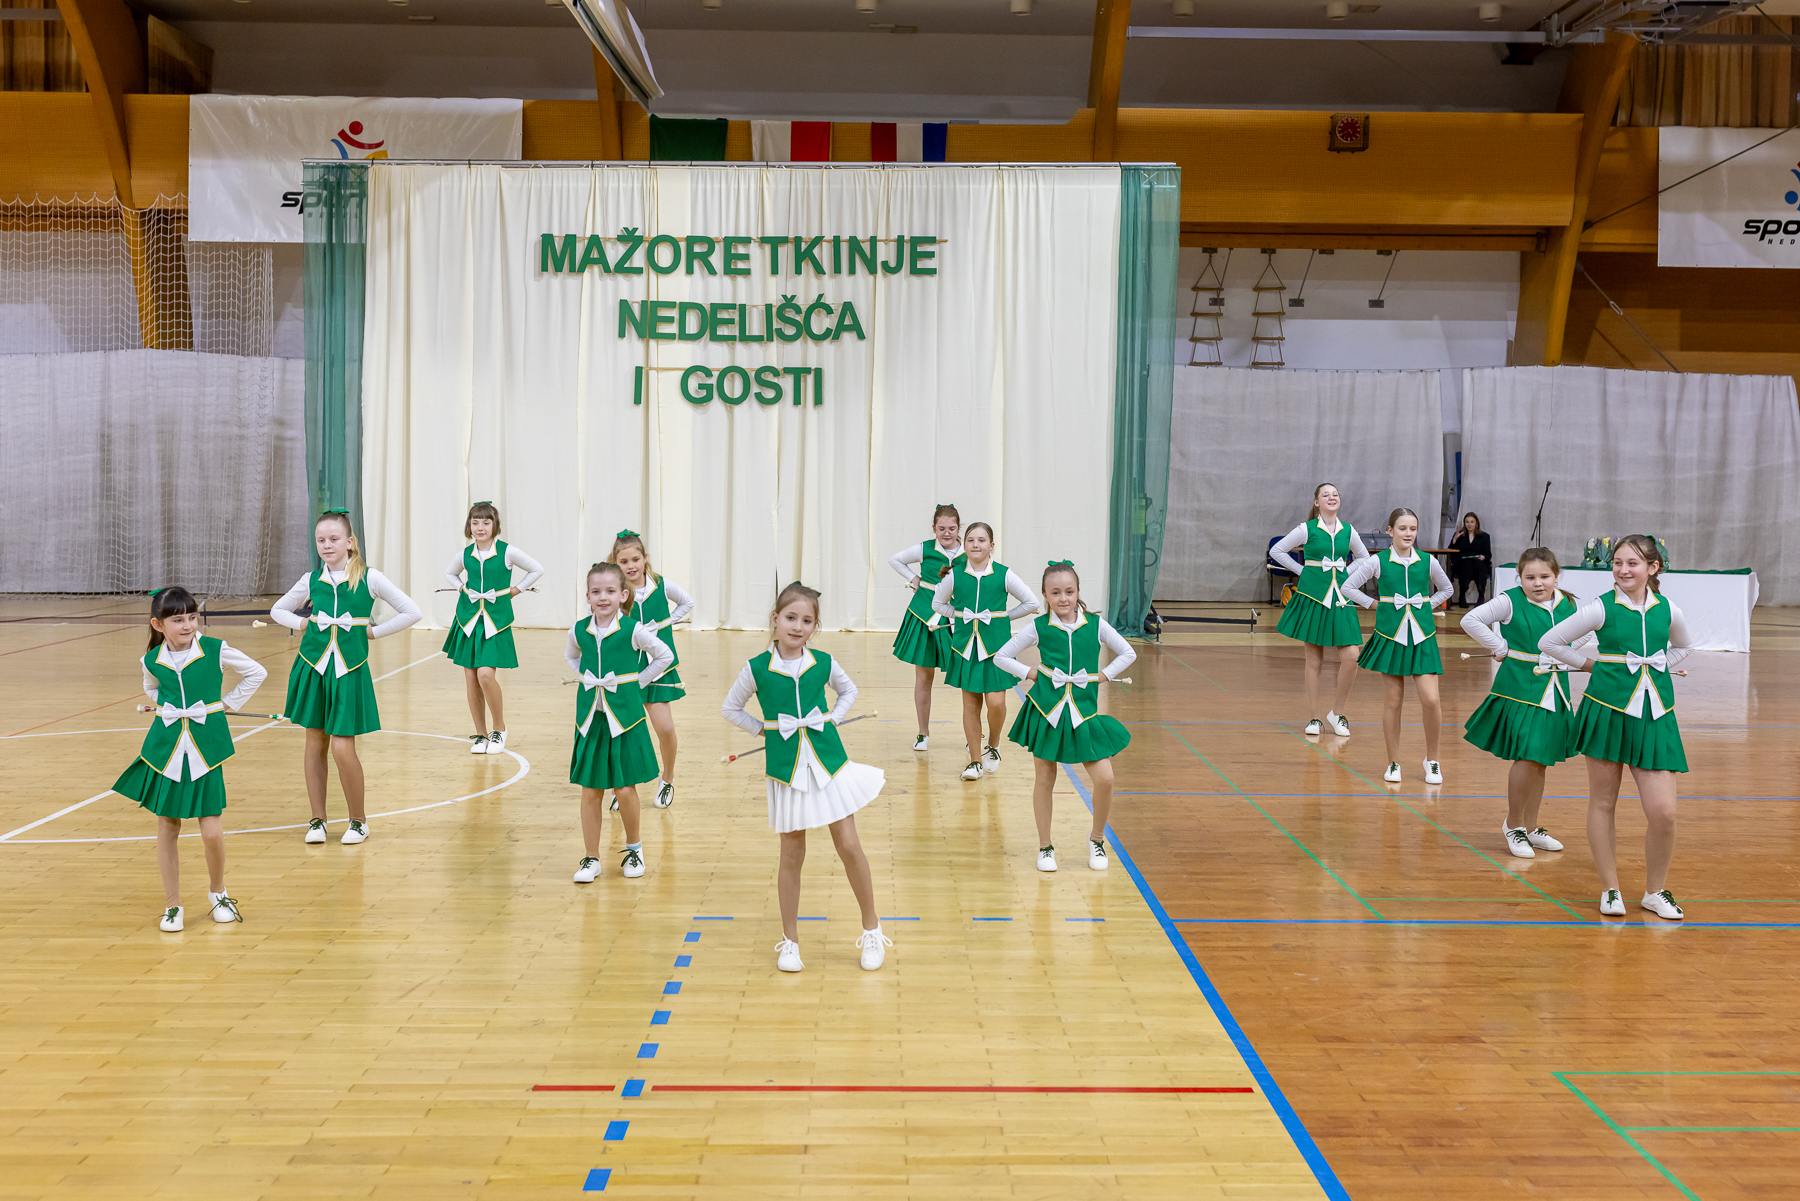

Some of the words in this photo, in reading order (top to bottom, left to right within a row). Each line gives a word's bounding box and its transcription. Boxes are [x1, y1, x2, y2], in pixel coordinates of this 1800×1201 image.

[541, 227, 938, 275] MAŽORETKINJE
[619, 293, 866, 342] NEDELIŠĆA
[633, 366, 643, 405] I
[681, 365, 824, 406] GOSTI
